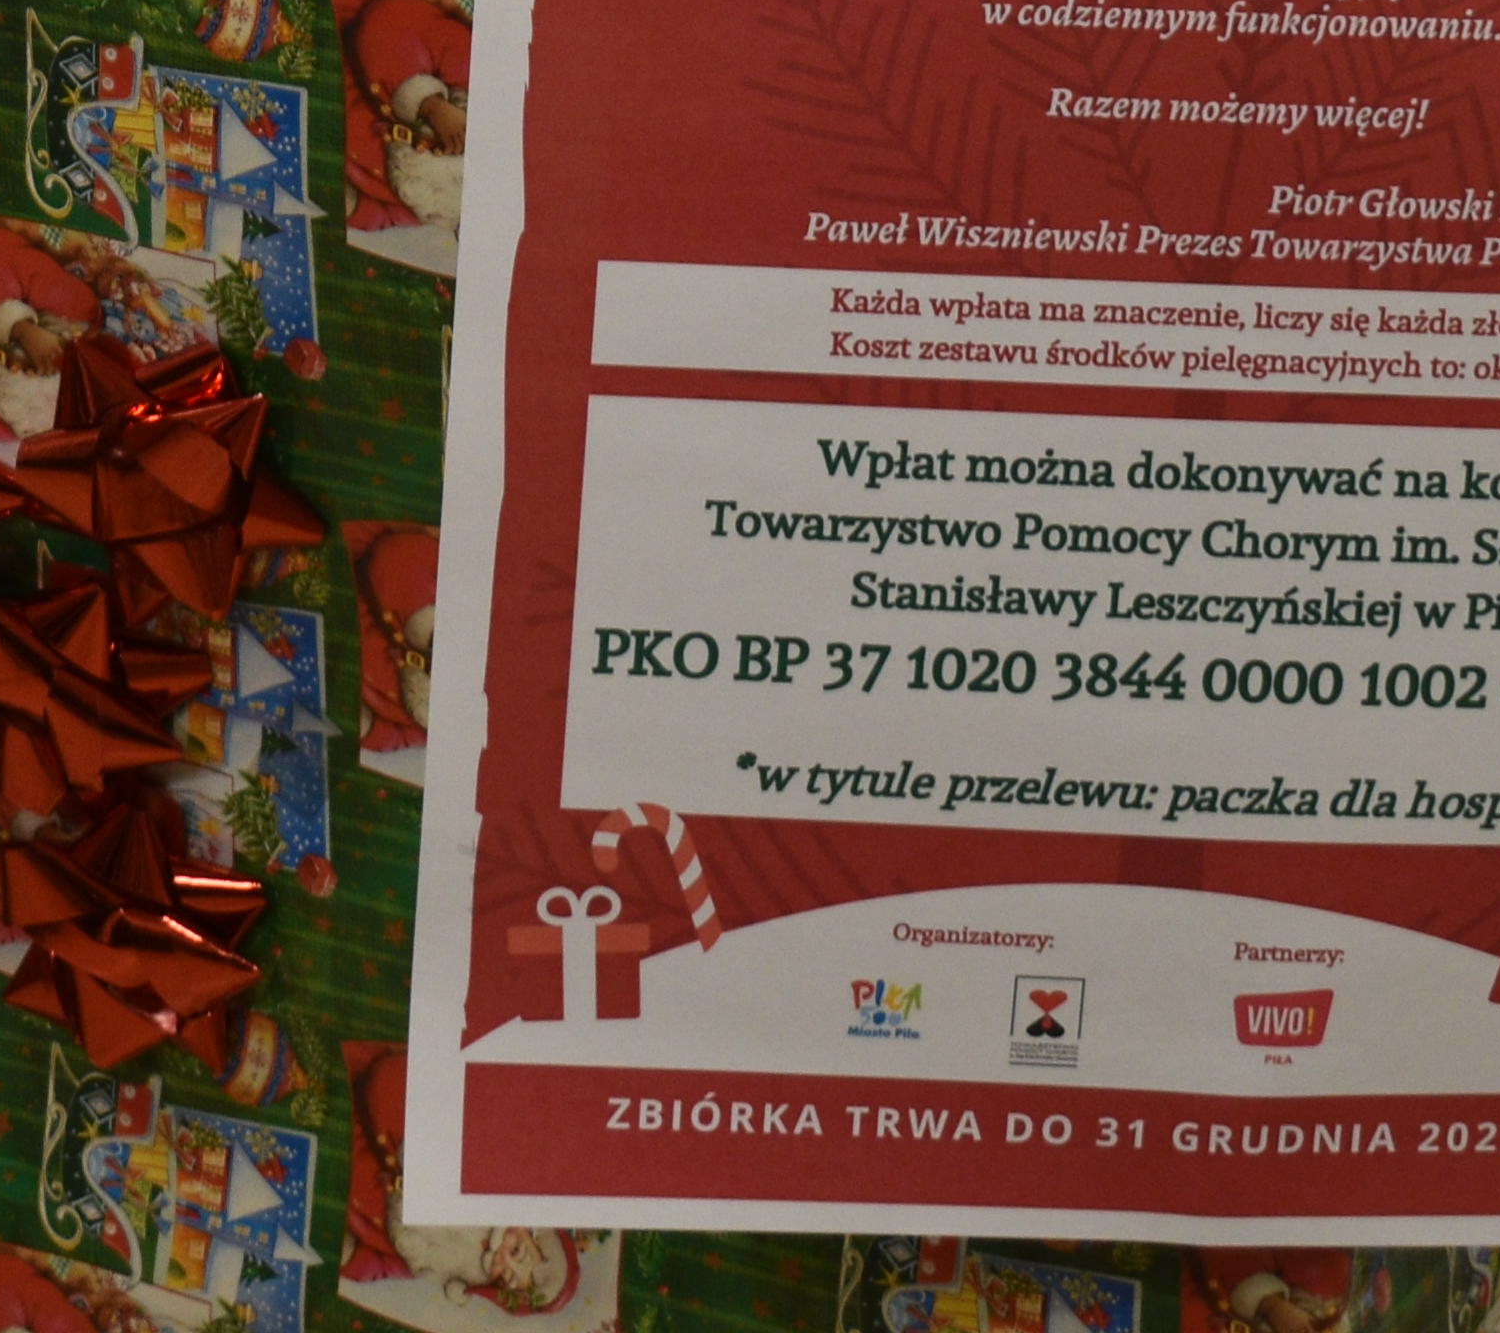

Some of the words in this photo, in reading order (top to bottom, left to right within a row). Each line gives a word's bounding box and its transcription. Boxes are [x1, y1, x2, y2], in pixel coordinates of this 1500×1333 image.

[1046, 87, 1162, 121] Razem
[1169, 91, 1309, 135] możemy
[1314, 96, 1430, 138] więcej!
[1267, 183, 1355, 217] Piotr
[1358, 185, 1495, 222] Głowski
[803, 211, 910, 245] Paweł
[916, 215, 1130, 254] Wiszniewski
[1134, 224, 1243, 258] Prezes
[1250, 228, 1473, 272] Towarzystwa
[830, 287, 922, 317] Każda
[928, 291, 1032, 326] wpłata
[1038, 301, 1086, 323] ma
[1093, 302, 1246, 332] znaczenie,
[1253, 301, 1324, 338] liczy
[1329, 306, 1371, 338] się
[1376, 305, 1464, 336] każda
[829, 331, 912, 360] Koszt
[918, 340, 1038, 365] zestawu
[1045, 338, 1176, 370] środków
[1181, 344, 1422, 384] pielęgnacyjnych
[1430, 357, 1466, 380] to:
[816, 438, 956, 490] Wpłat
[964, 448, 1116, 488] można
[1126, 449, 1384, 505] dokonywać
[1393, 469, 1450, 499] na
[704, 499, 1002, 555] Towarzystwo
[1012, 512, 1192, 567] Pomocy
[1201, 518, 1381, 572] Chorym
[1390, 525, 1460, 565] im.
[850, 570, 1098, 628] Stanisławy
[1105, 581, 1403, 638] Leszczyńskiej
[1413, 601, 1456, 629] w
[591, 627, 720, 680] PKO
[733, 634, 811, 684] BP
[822, 642, 892, 693] 37
[907, 645, 1037, 695] 1020
[1051, 650, 1187, 702] 3844
[1202, 658, 1344, 706] 0000
[1360, 662, 1487, 710] 1002
[806, 759, 936, 806] tytule
[939, 766, 1159, 812] przelewu:
[1161, 776, 1319, 823] paczka
[1329, 778, 1398, 819] dla
[892, 922, 1055, 954] Organizatorzy:
[1233, 941, 1345, 969] Partnerzy:
[1248, 1004, 1315, 1037] VIVO!
[606, 1091, 823, 1136] ZBIÓRKA
[845, 1105, 982, 1142] TRWA
[1005, 1112, 1073, 1146] DO
[1095, 1116, 1145, 1149] 31
[1172, 1121, 1396, 1155] GRUDNIA
